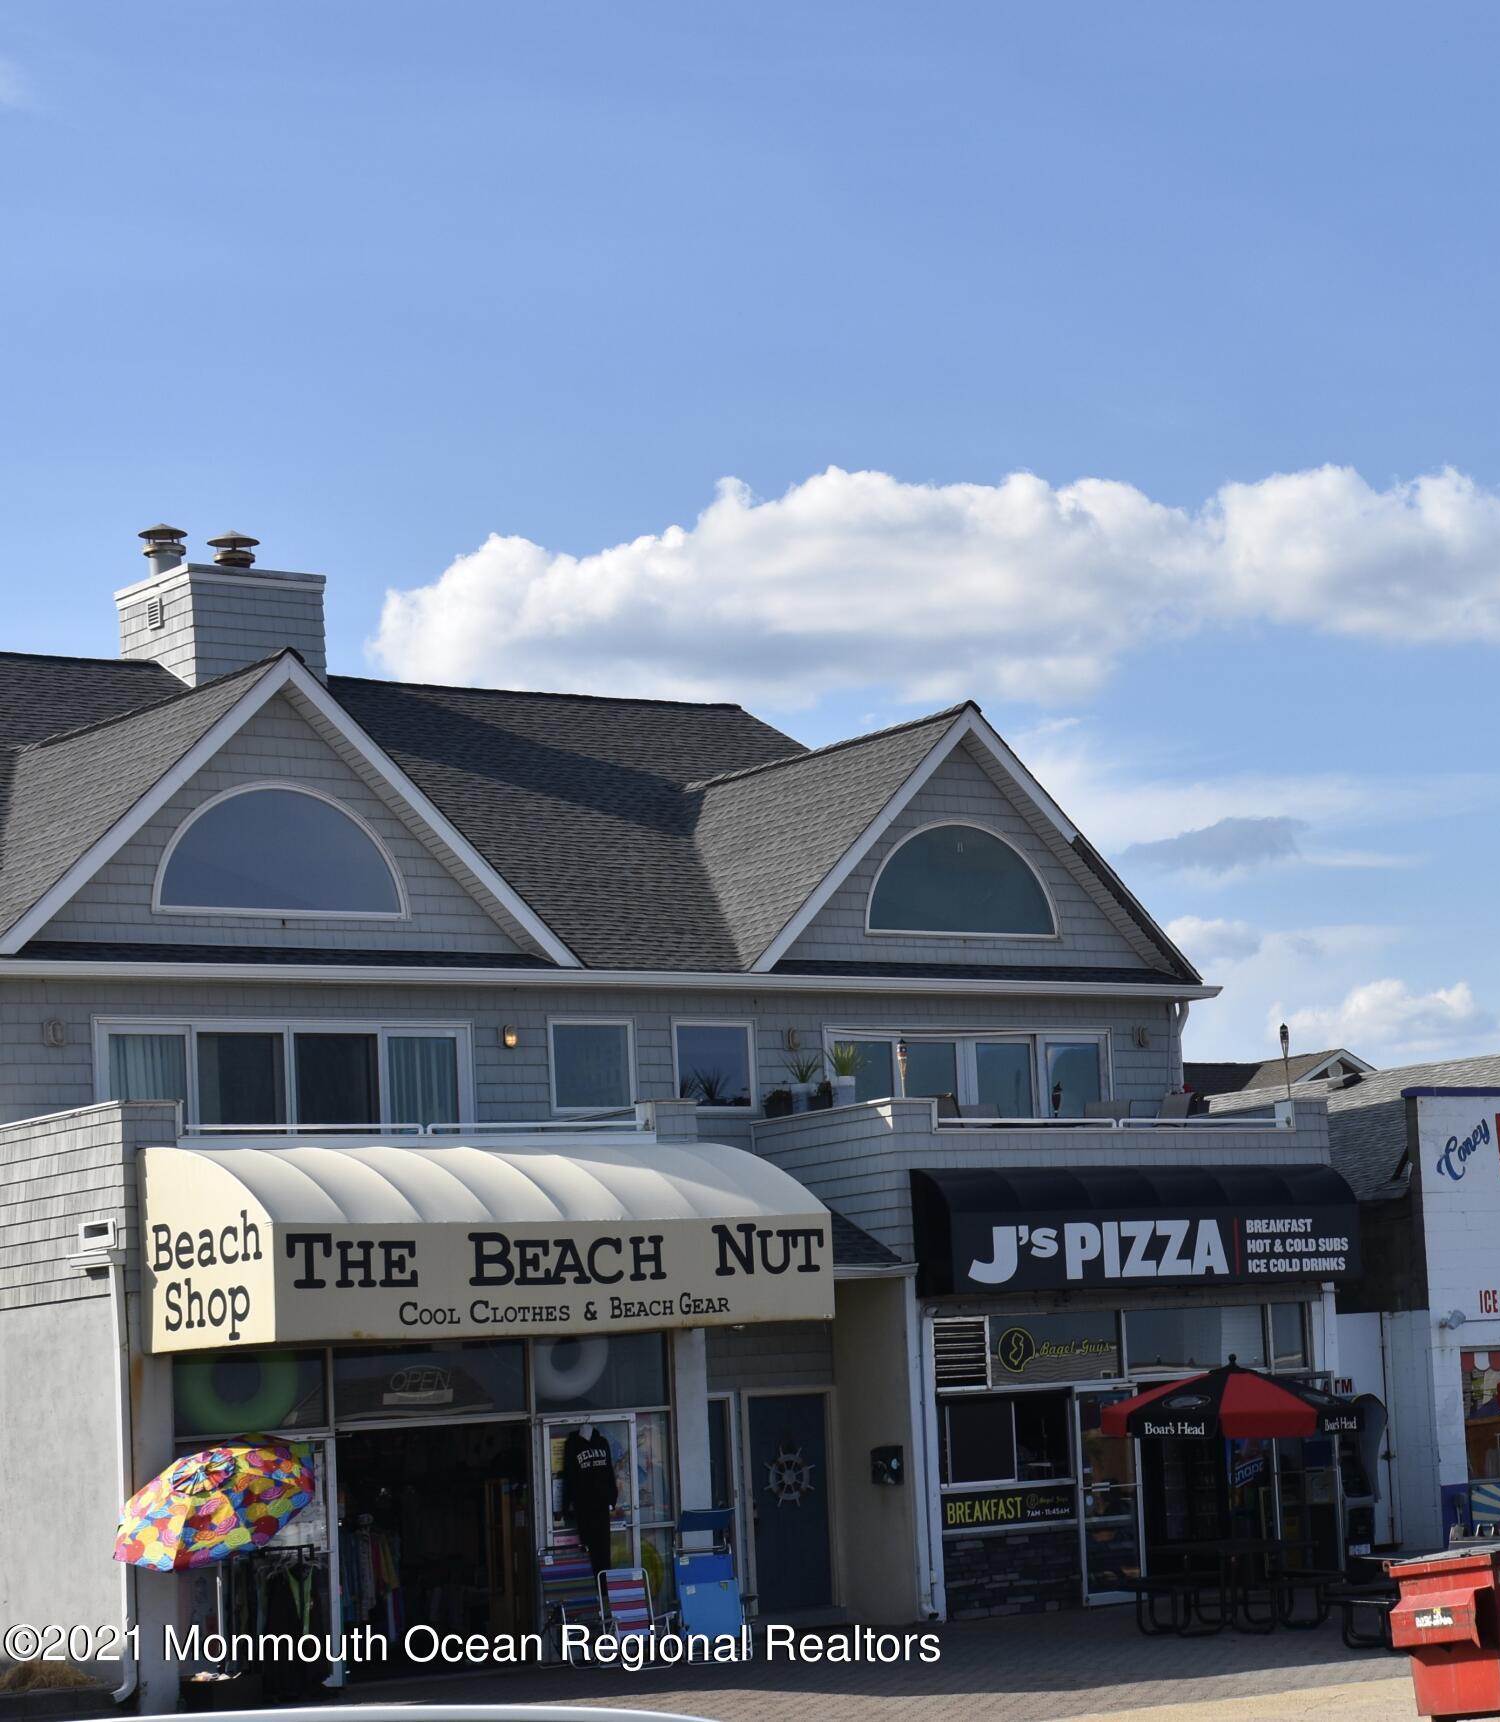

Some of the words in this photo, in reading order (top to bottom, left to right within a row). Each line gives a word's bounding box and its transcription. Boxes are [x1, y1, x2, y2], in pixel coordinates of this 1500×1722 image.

[1436, 1118, 1490, 1181] Coney
[1245, 1218, 1313, 1234] BREAKFAST
[152, 1210, 263, 1273] Beach
[1064, 1218, 1230, 1281] PIZZA
[1247, 1238, 1272, 1252] HOT
[1274, 1239, 1283, 1252] &
[1285, 1238, 1316, 1252] COLD
[1318, 1237, 1349, 1252] SUBS
[286, 1232, 419, 1288] THE
[468, 1231, 667, 1287] BEACH
[711, 1222, 825, 1276] NUT
[1247, 1259, 1267, 1274] ICE
[1269, 1258, 1300, 1273] COLD
[1301, 1256, 1346, 1272] DRINKS
[165, 1278, 252, 1341] Shop
[399, 1301, 461, 1326] COOL
[470, 1299, 571, 1324] CLOTHES
[583, 1301, 598, 1321] &
[610, 1294, 675, 1320] BEACH
[679, 1292, 731, 1315] GEAR
[1479, 1290, 1498, 1314] ICE
[1039, 1340, 1075, 1358] Bagel
[390, 1371, 452, 1391] OPEN
[1322, 1379, 1354, 1393] ATM
[1144, 1421, 1175, 1435] Boar's
[1177, 1421, 1205, 1436] Head
[1340, 1416, 1357, 1430] Head
[946, 1496, 1022, 1525] BREAKFAST
[1026, 1510, 1041, 1518] 7AM
